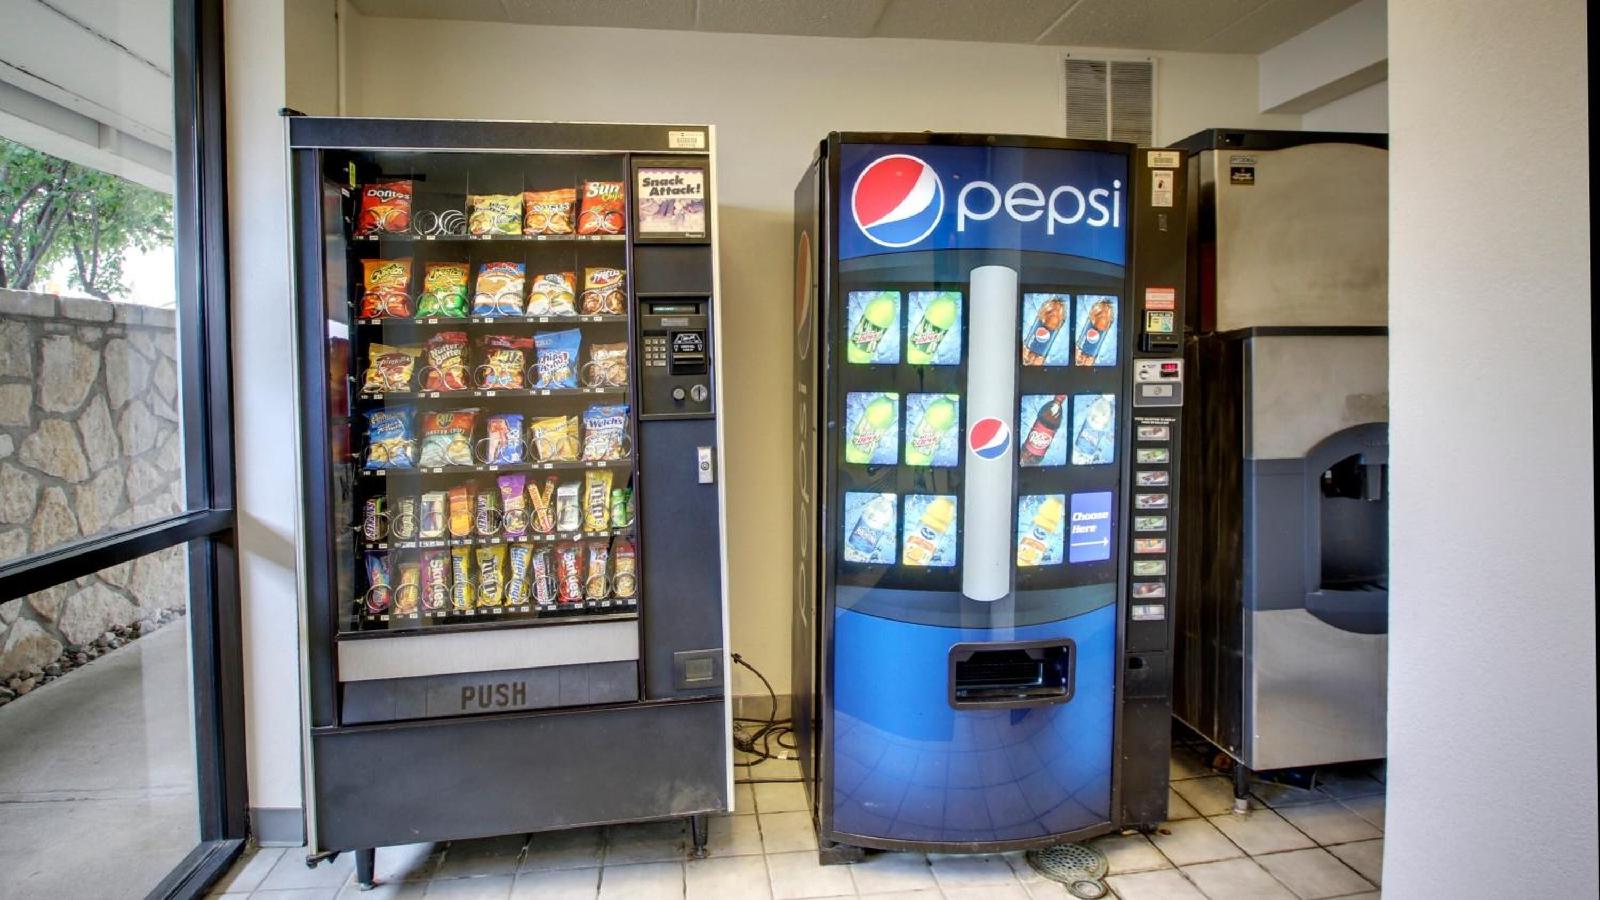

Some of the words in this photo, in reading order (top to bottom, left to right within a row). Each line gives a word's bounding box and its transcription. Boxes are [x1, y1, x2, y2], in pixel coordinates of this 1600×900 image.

[642, 175, 684, 187] Snack
[367, 189, 411, 200] Doritos
[586, 181, 620, 198] Sun
[649, 184, 701, 196] Attack!
[956, 179, 1122, 235] pepsi
[430, 343, 460, 358] Nutter
[436, 350, 462, 365] Butter
[589, 417, 623, 428] Welch's
[1072, 511, 1109, 521] Choose
[1072, 525, 1097, 534] Here
[461, 681, 527, 710] PUSH
